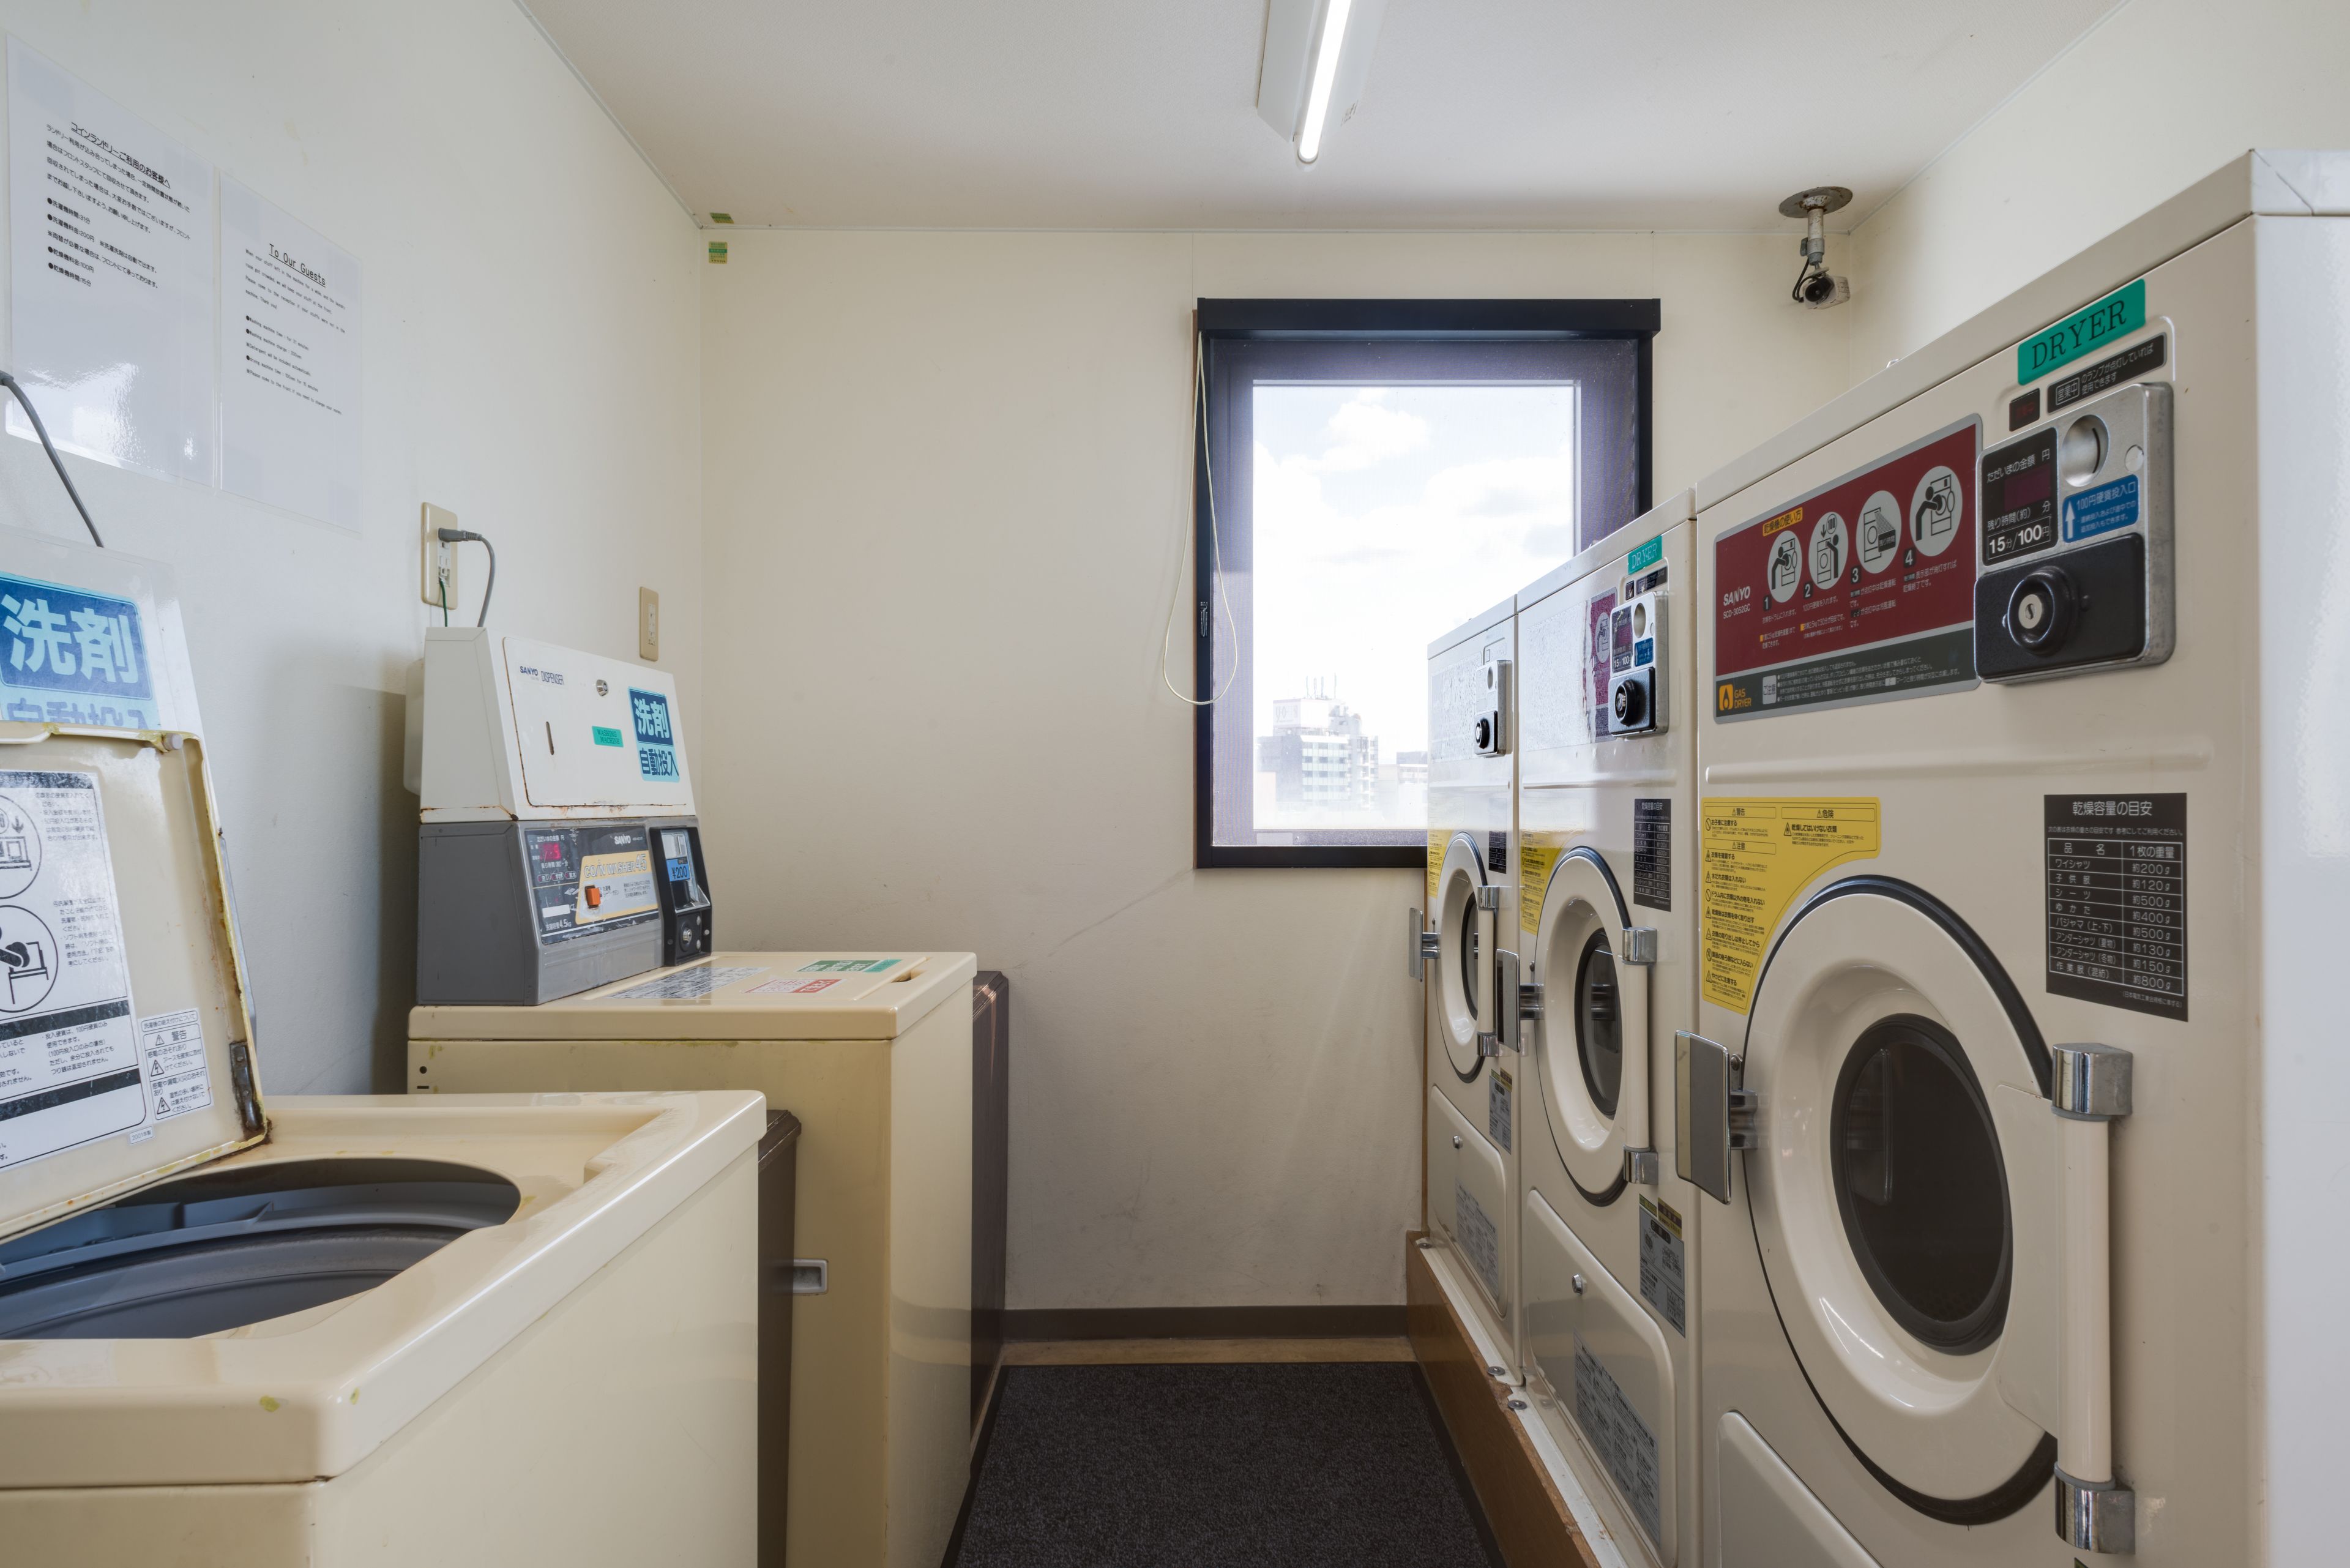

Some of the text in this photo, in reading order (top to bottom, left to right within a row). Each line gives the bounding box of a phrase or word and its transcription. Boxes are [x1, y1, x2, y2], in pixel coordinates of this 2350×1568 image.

[71, 122, 171, 189] コインランドリーご利用のお客様へ
[269, 244, 326, 286] To Our Guests
[2032, 300, 2127, 370] DRYER
[2081, 371, 2117, 395] 使用できます
[2057, 379, 2079, 403] 営業中
[1986, 449, 2050, 483] ただいまの金額 円
[2076, 481, 2136, 510] 100円硬貨投入口
[2042, 501, 2051, 513] 分
[1764, 509, 1802, 535] 乾燥機の使い方
[1632, 543, 1657, 569] DRYER
[1905, 550, 1913, 565] 4
[1852, 567, 1859, 583] 3
[1723, 586, 1751, 607] SANYO
[1804, 584, 1811, 598] 2
[1764, 597, 1769, 610] 1
[1, 594, 139, 684] 洗剤
[520, 666, 564, 685] SANYO DISPENSER
[1734, 689, 1746, 699] GAS
[1734, 696, 1752, 709] DRYER
[634, 698, 670, 739] 洗剤
[597, 729, 617, 737] WASHING
[600, 736, 620, 745] MACHINE
[640, 747, 679, 777] 自動投入
[1822, 809, 1834, 818] 危険
[2072, 801, 2153, 816] 乾燥容量の目安
[1791, 824, 1837, 833] 乾燥してはいけない衣類
[614, 835, 631, 845] SANYO
[2130, 845, 2174, 859] 1枚の重量
[584, 854, 647, 878] COIN WASHER 45
[671, 865, 688, 879] ¥200
[2055, 859, 2170, 875] ワイシャツ 約200g
[2132, 879, 2170, 891] 約120g
[2132, 895, 2170, 908] 約500g
[2133, 911, 2170, 924] 約400g
[2133, 927, 2170, 940] 約500g
[2133, 943, 2170, 957] 約130g
[2133, 958, 2171, 973] 約150g
[2133, 974, 2171, 990] 約800g
[171, 1030, 187, 1041] 警告
[132, 1130, 152, 1141] 2001年製
